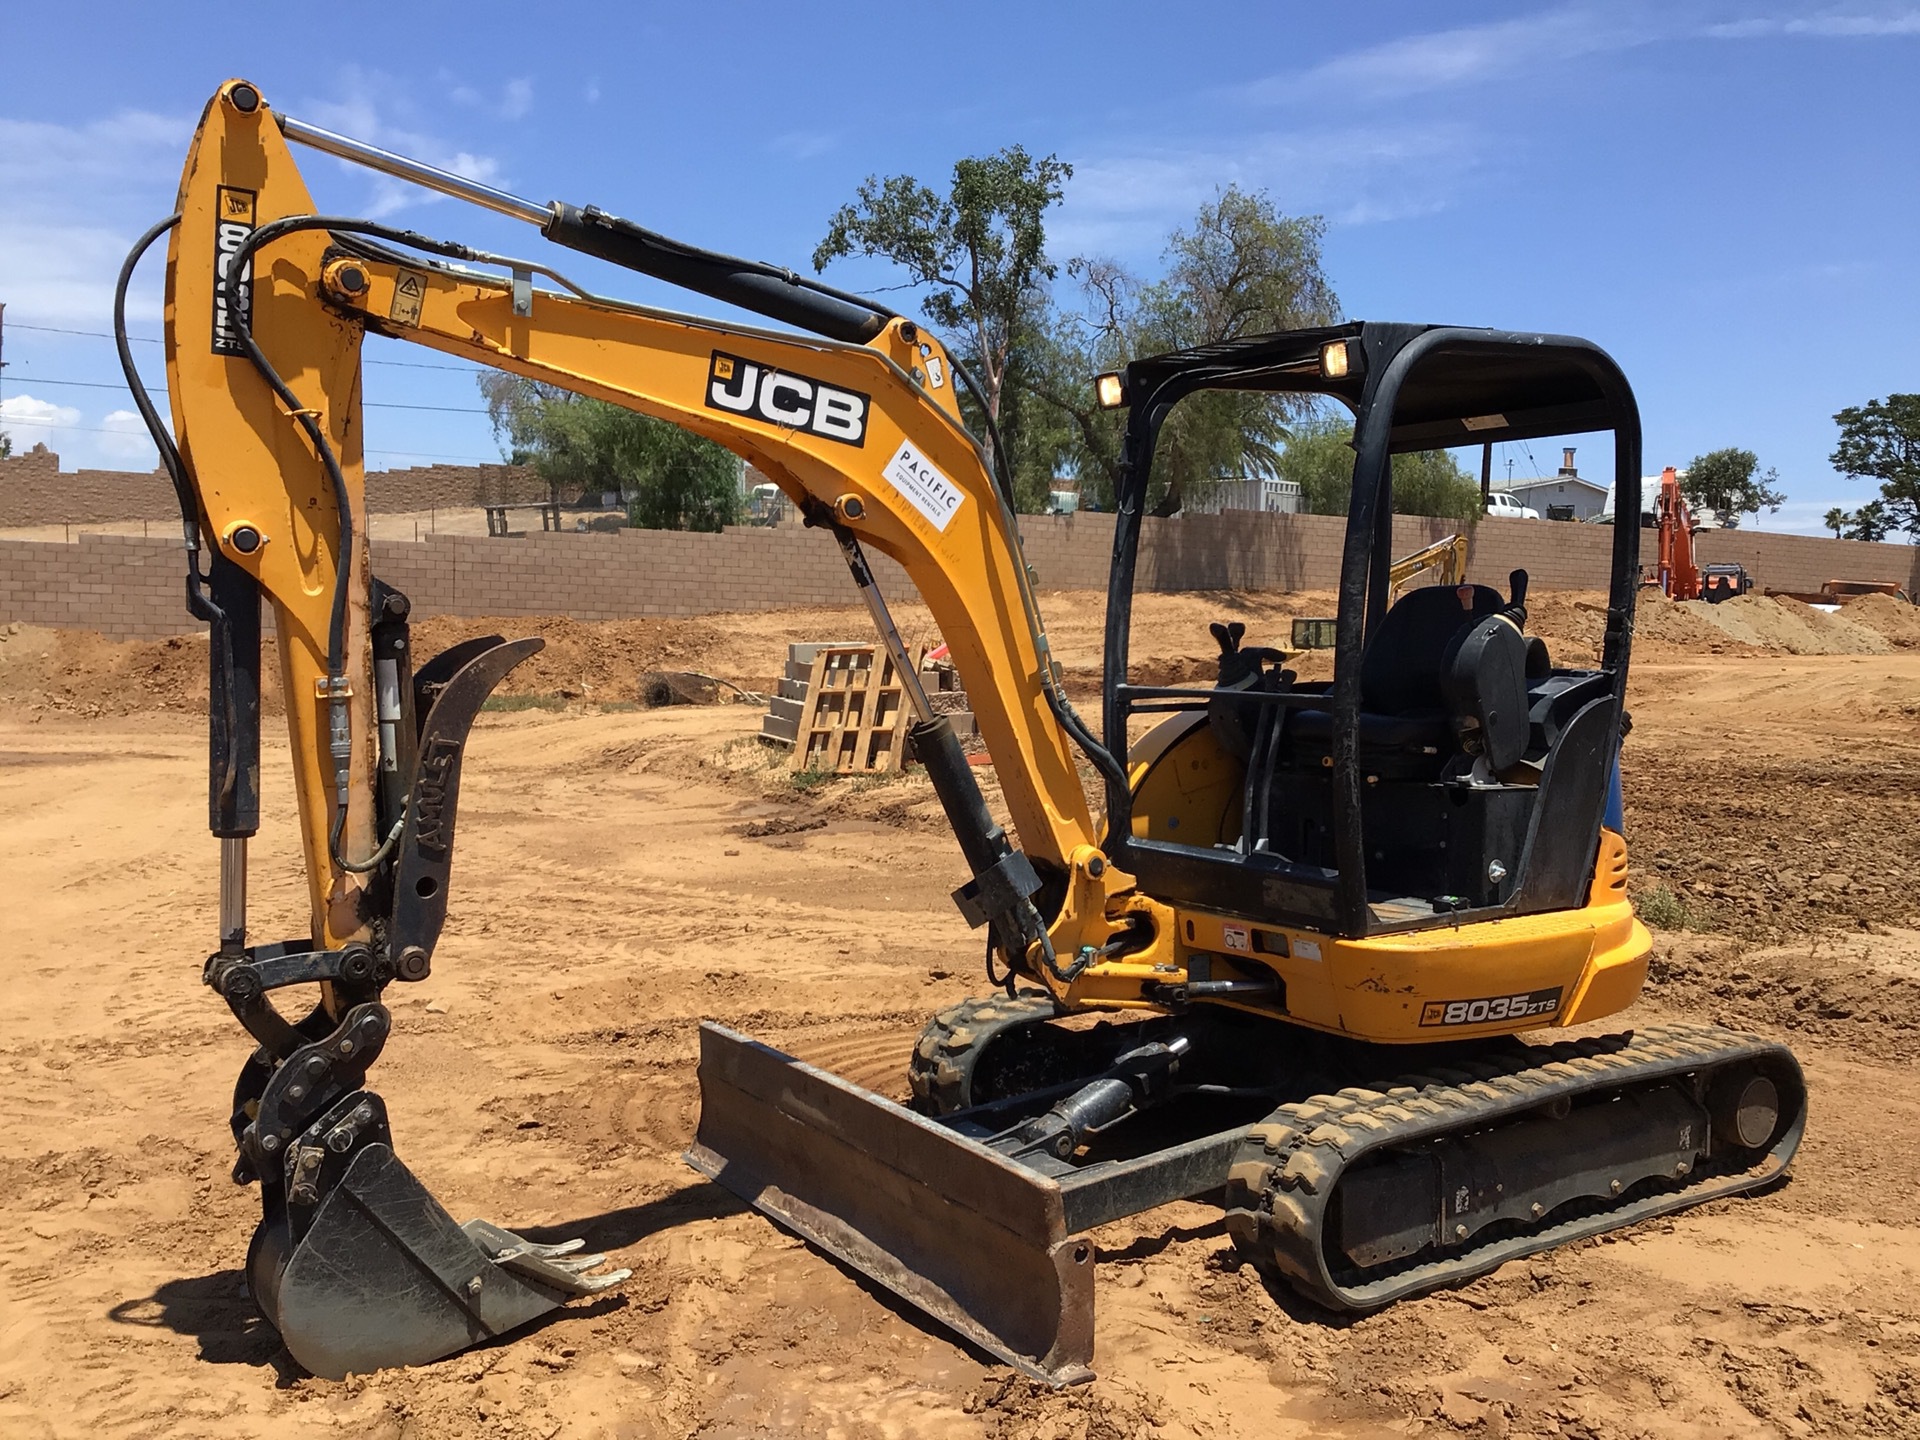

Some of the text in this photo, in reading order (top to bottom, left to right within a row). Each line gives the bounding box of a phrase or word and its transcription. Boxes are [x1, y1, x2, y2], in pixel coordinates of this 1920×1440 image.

[229, 197, 249, 214] JCB
[711, 364, 864, 440] JCB
[896, 472, 922, 498] EQUIPMENT
[921, 497, 941, 517] RENTALS
[899, 450, 957, 509] PACIFIC
[1444, 994, 1557, 1024] 8035 ZTS
